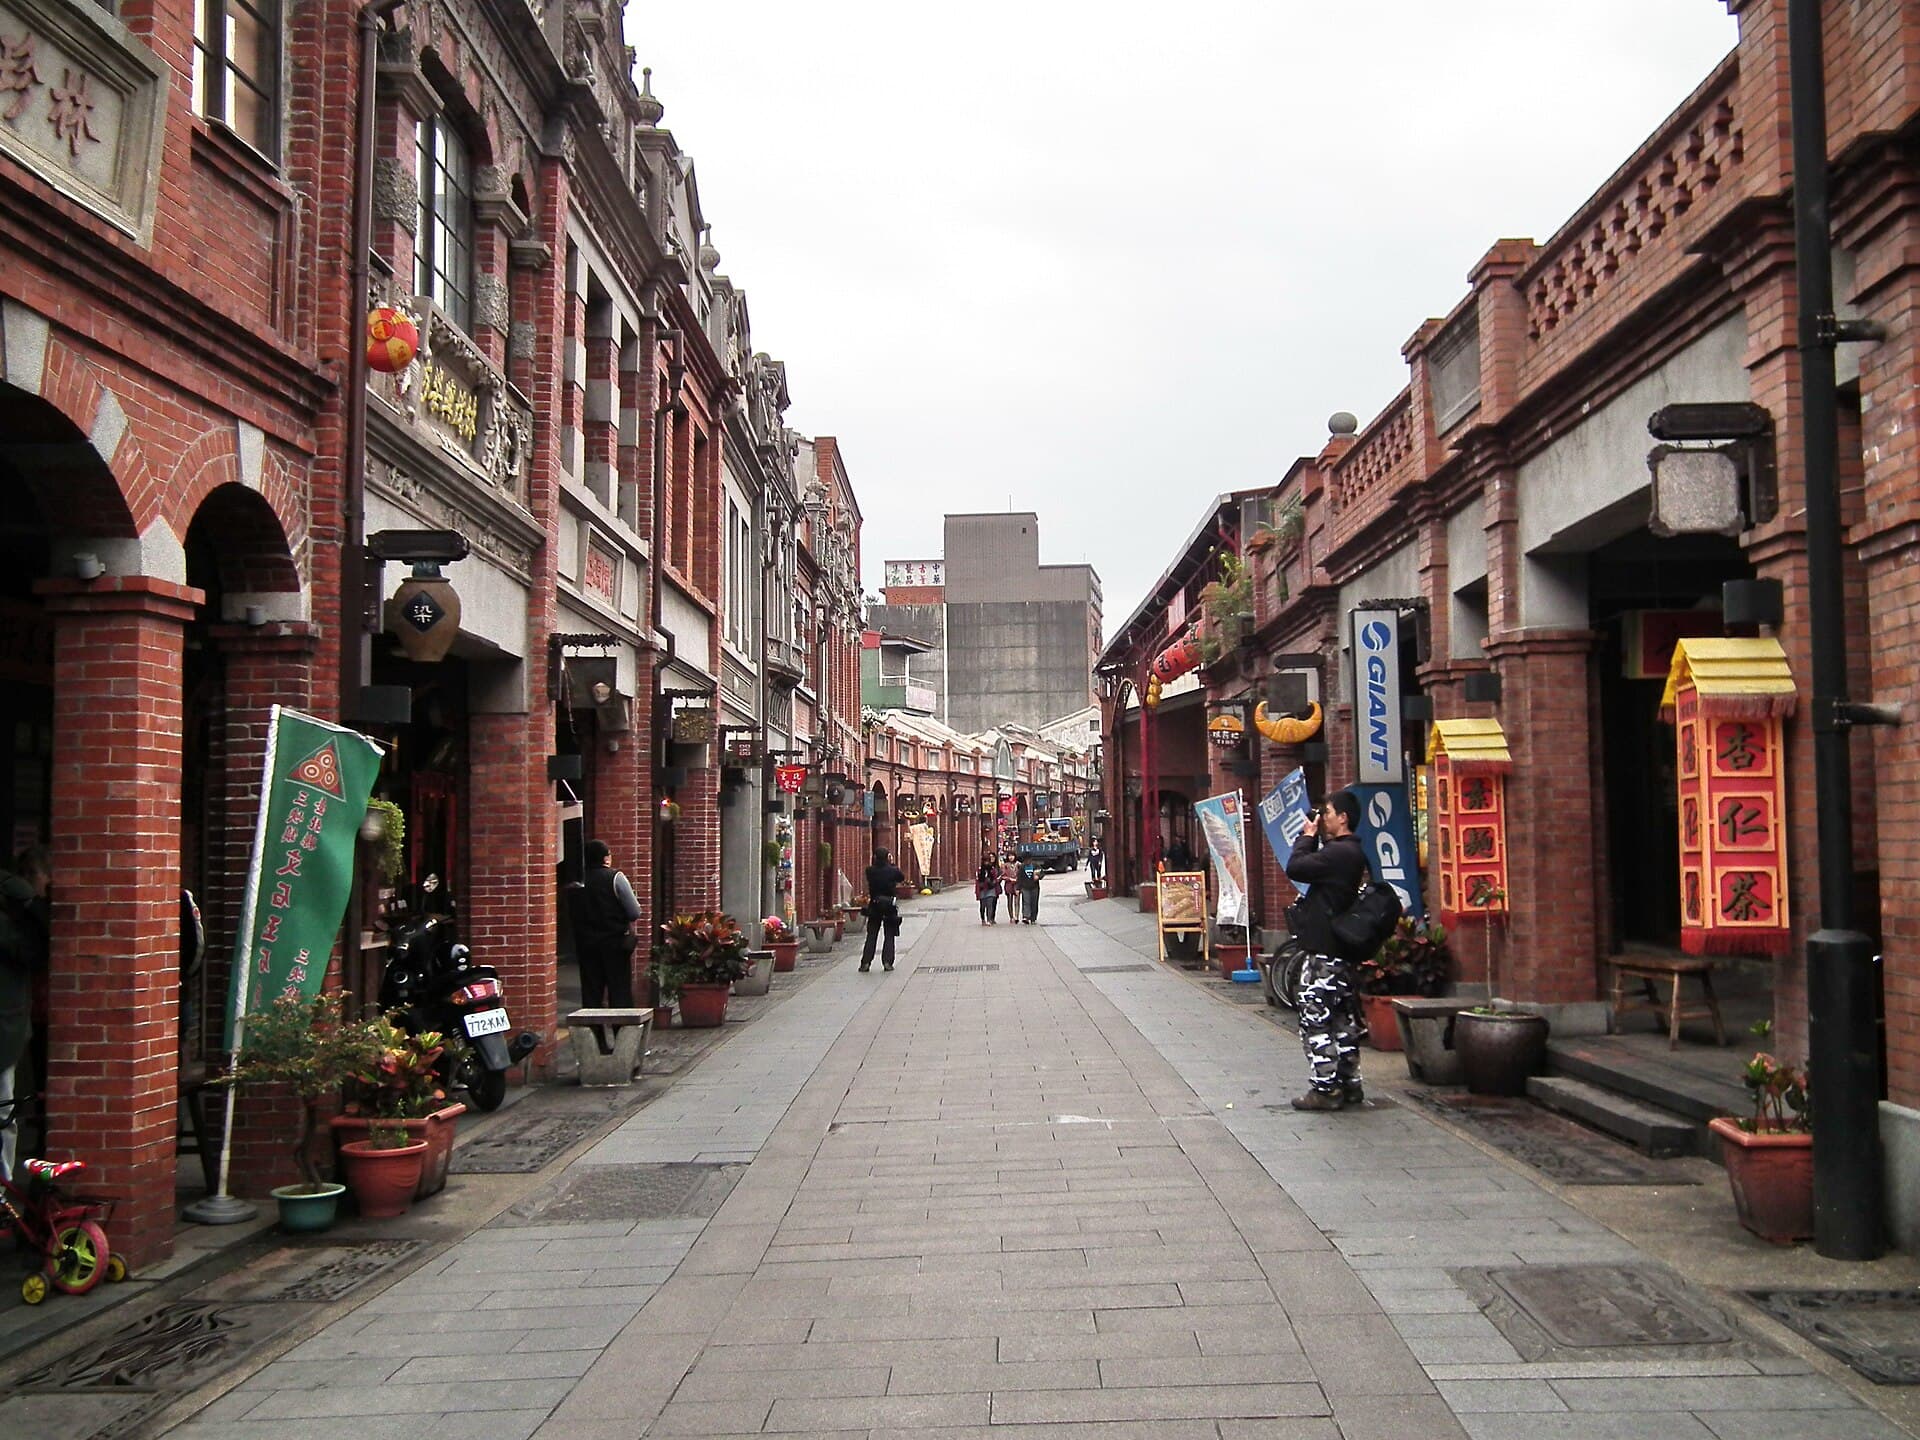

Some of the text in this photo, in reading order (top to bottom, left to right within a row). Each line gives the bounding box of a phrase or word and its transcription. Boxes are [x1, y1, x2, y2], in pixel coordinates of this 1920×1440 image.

[413, 605, 433, 623] 染
[1367, 655, 1389, 771] GIANT
[1719, 725, 1772, 921] 杏仁茶
